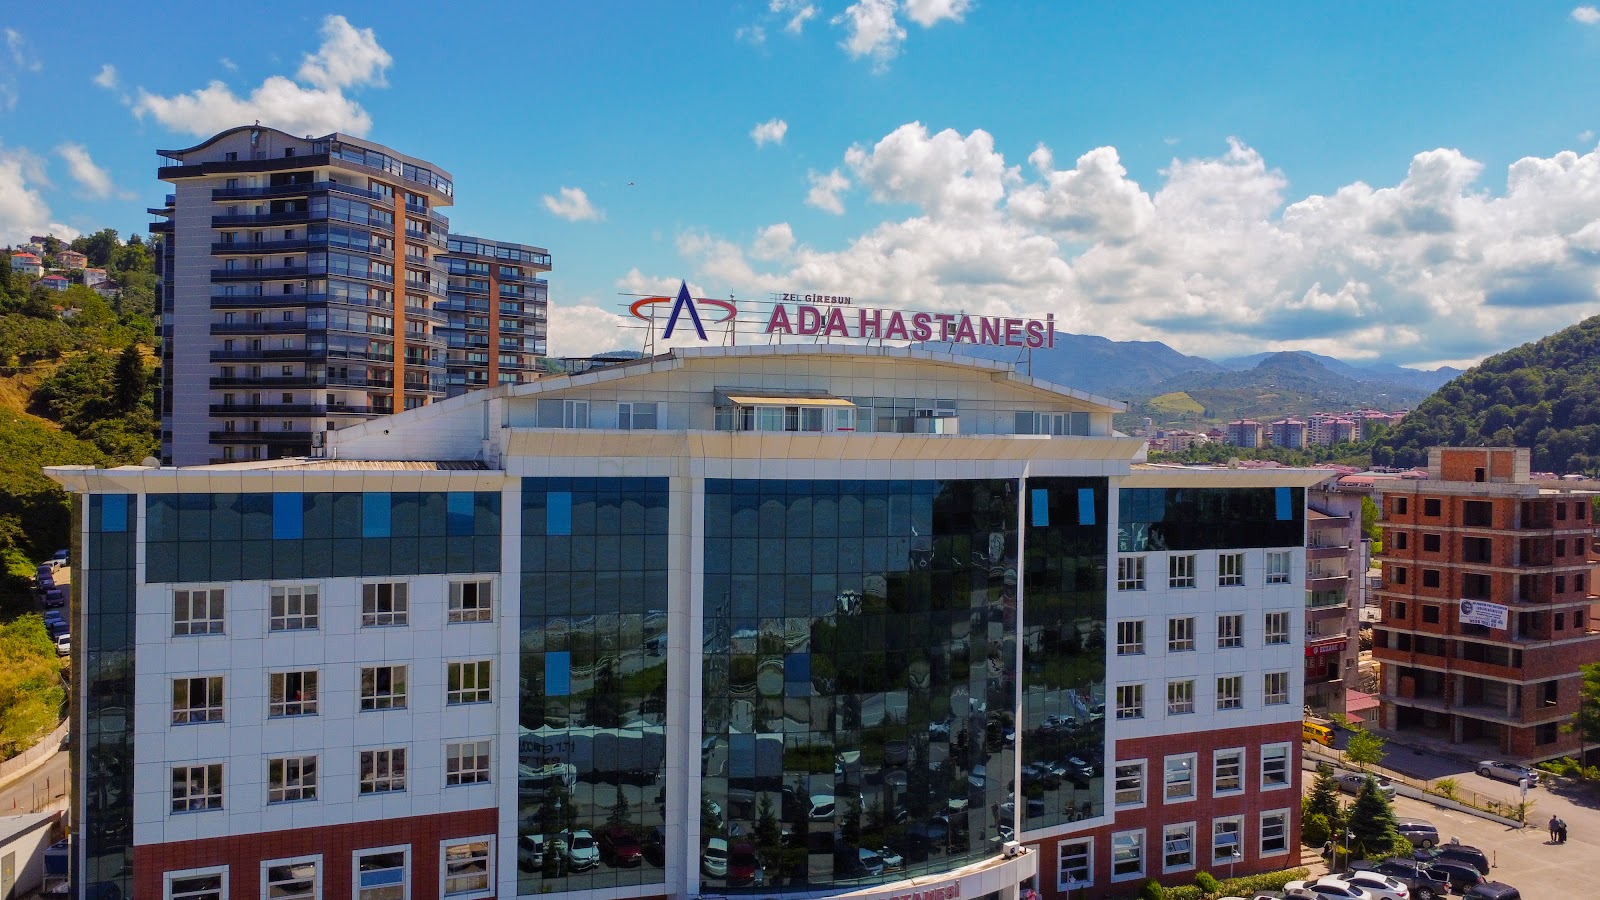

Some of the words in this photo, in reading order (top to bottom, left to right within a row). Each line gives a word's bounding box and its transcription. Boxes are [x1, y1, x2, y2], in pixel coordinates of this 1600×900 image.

[805, 293, 851, 304] GİRESUN
[765, 304, 849, 338] ADA
[858, 308, 1055, 349] HASTANESİ
